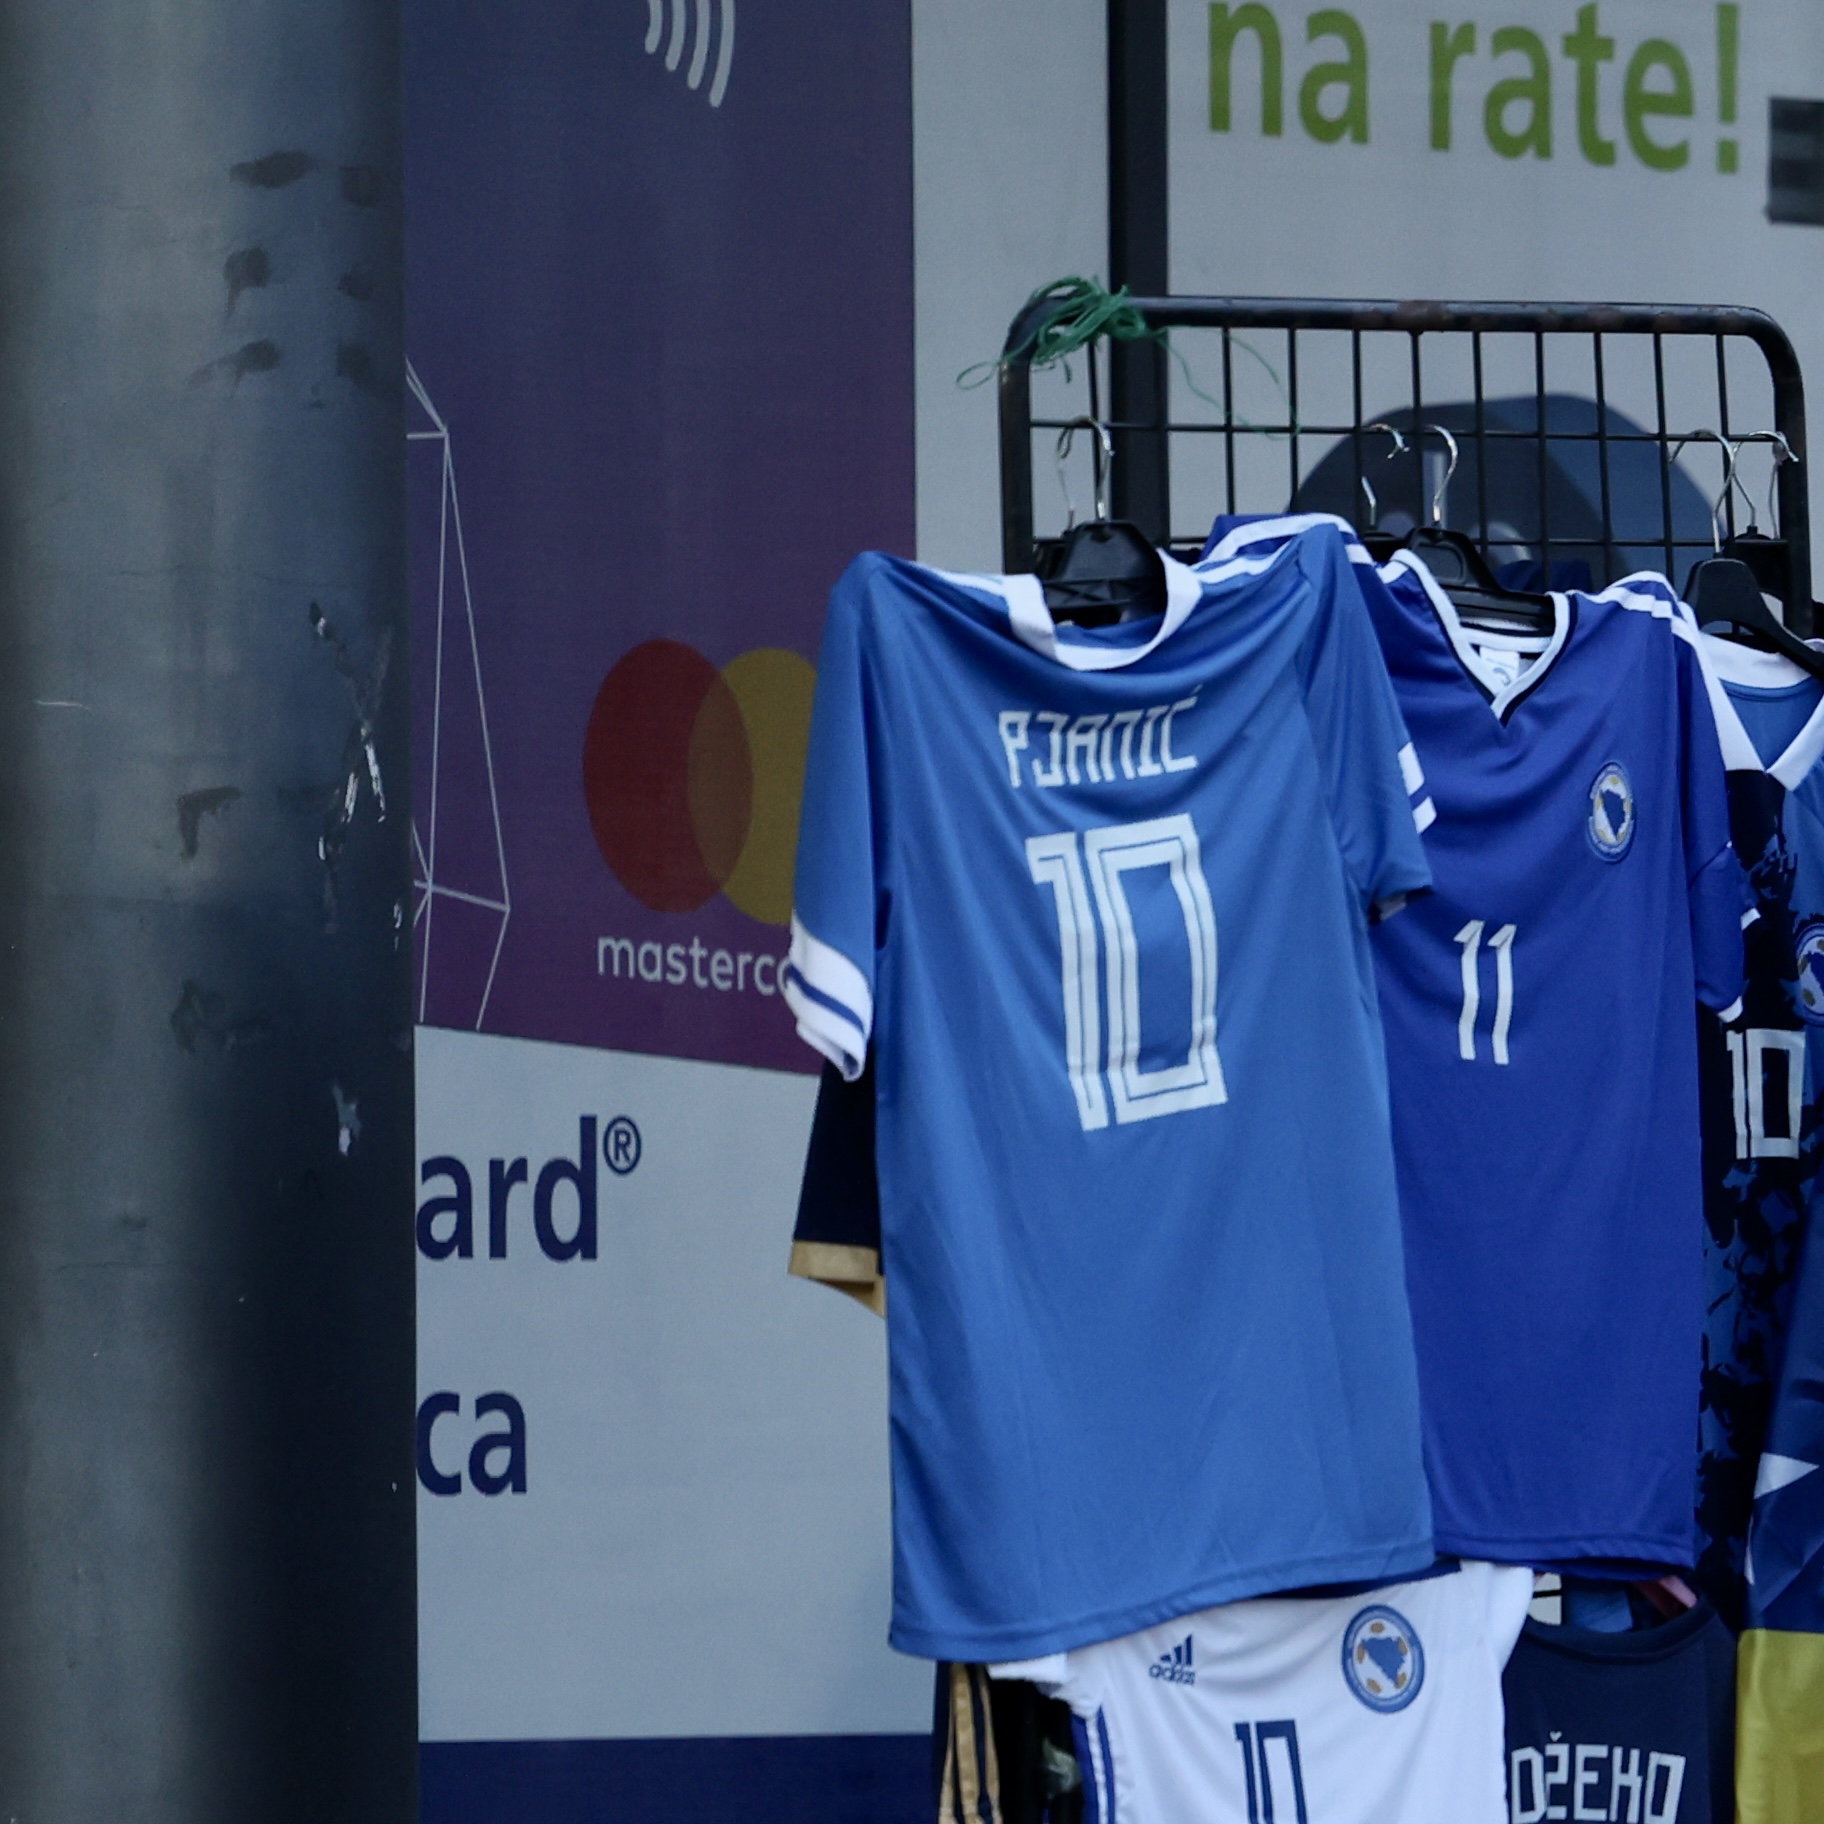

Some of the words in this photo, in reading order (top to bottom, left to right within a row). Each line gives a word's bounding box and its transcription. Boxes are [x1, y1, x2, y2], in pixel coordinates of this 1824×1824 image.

[1208, 0, 1369, 144] na
[1430, 2, 1738, 174] rate!
[1025, 813, 1228, 1131] 10
[1454, 920, 1517, 1065] 11
[1727, 1028, 1805, 1160] 10
